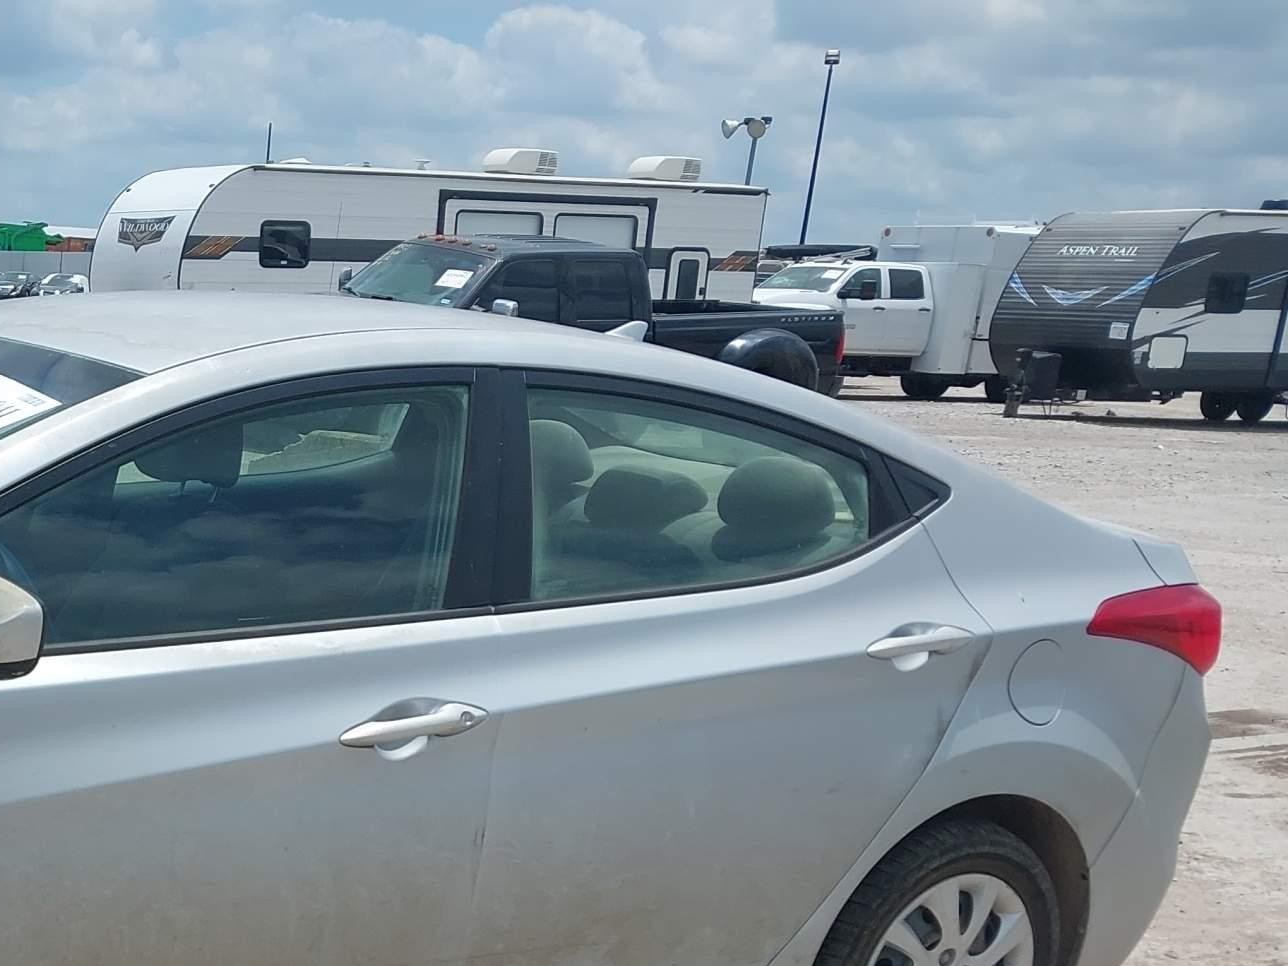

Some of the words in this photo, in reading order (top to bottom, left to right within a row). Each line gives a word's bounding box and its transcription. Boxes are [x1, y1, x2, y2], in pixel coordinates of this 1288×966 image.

[119, 219, 170, 233] WILDWOOD
[1056, 244, 1100, 256] ASPEN
[1101, 244, 1140, 256] TRAIL
